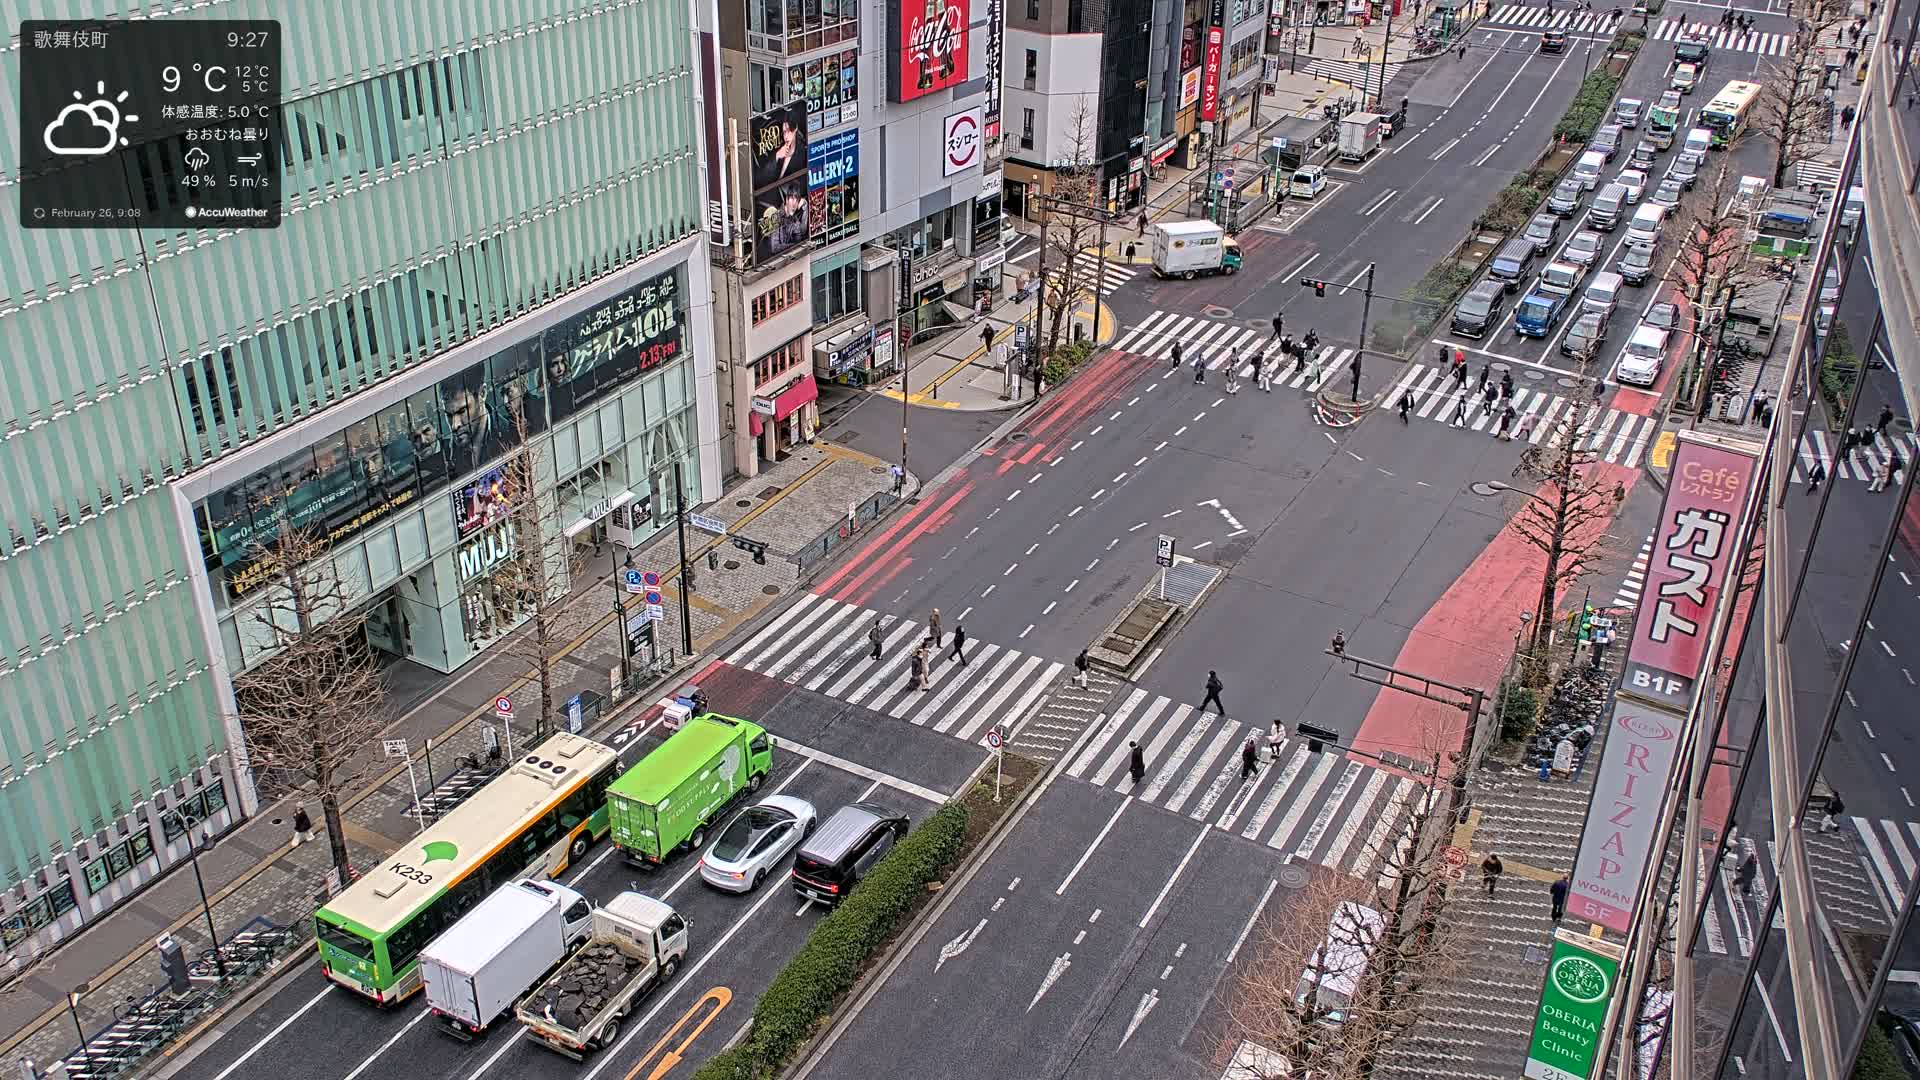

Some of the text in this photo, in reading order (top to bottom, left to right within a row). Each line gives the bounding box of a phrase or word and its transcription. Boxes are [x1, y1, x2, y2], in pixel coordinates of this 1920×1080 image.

[908, 5, 962, 65] Coca-Cola
[1205, 45, 1220, 111] バーガーキング
[946, 133, 979, 153] スシロー
[709, 199, 723, 234] MUJI
[640, 340, 676, 369] 2.13 FRI
[829, 351, 839, 367] P
[1683, 462, 1740, 490] Café
[1680, 480, 1735, 503] レストラン
[591, 496, 615, 520] MUJI
[459, 522, 517, 582] MUJI
[1160, 540, 1168, 549] P
[1650, 508, 1730, 643] ガスト
[1631, 669, 1682, 697] B1F
[1597, 742, 1652, 881] RIZAP
[389, 862, 433, 885] K233
[1577, 879, 1631, 905] WOMAN
[1583, 901, 1612, 921] 5F
[1558, 970, 1601, 992] OBERIA
[1542, 1004, 1597, 1033] OBERIA
[1542, 1019, 1590, 1047] Beauty
[1541, 1038, 1583, 1062] Clinic
